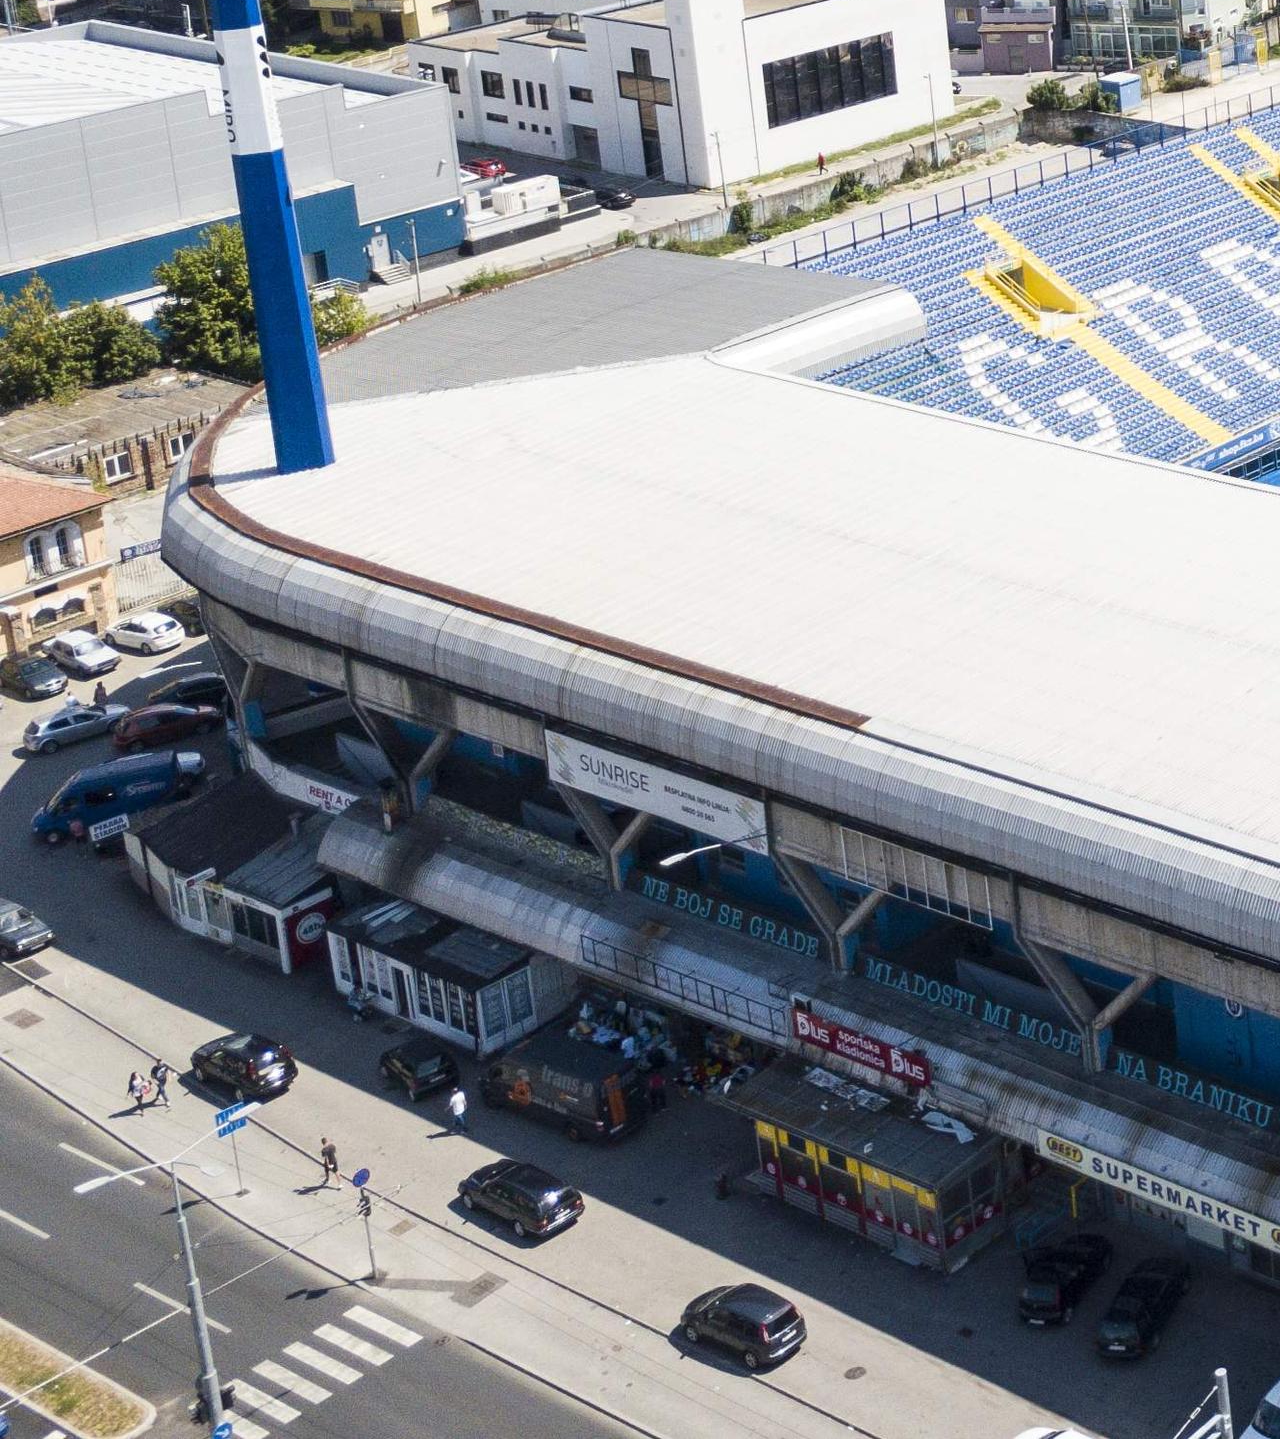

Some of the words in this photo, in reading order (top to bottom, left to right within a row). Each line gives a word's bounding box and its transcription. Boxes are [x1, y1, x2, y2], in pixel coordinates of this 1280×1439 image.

[580, 754, 650, 793] SUNRISE
[309, 785, 336, 804] RENT
[335, 796, 342, 805] A
[642, 876, 670, 903] NE
[674, 888, 714, 918] BOJ
[718, 904, 743, 930] SE
[750, 916, 819, 958] GRADE
[865, 958, 977, 1015] MLADOSTI
[982, 1000, 1012, 1030] MI
[1017, 1014, 1082, 1057] MOJE
[836, 1040, 885, 1068] kladionica
[838, 1030, 880, 1054] sportska
[1116, 1052, 1148, 1082] NA
[1158, 1065, 1273, 1129] BRANIKU
[1051, 1140, 1080, 1161] BEST
[1091, 1157, 1261, 1237] SUPERMARKET
